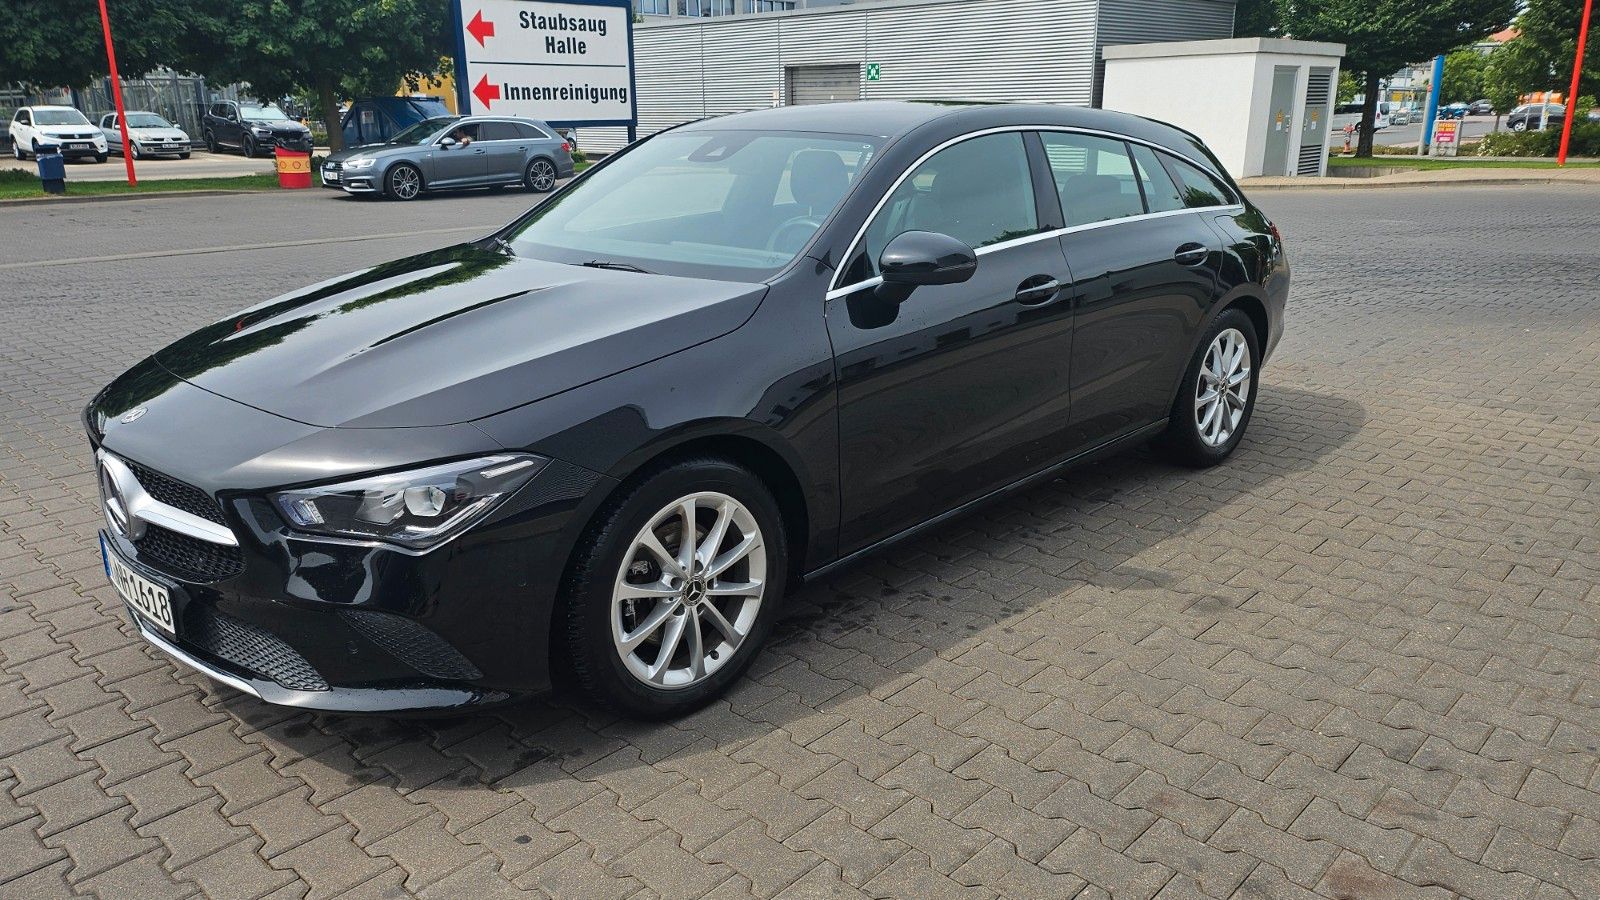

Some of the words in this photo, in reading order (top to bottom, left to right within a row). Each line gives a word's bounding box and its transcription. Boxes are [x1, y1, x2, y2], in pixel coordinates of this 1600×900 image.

[519, 10, 607, 37] Staubsaug
[545, 36, 587, 55] Halle
[504, 83, 627, 104] Innenreinigung
